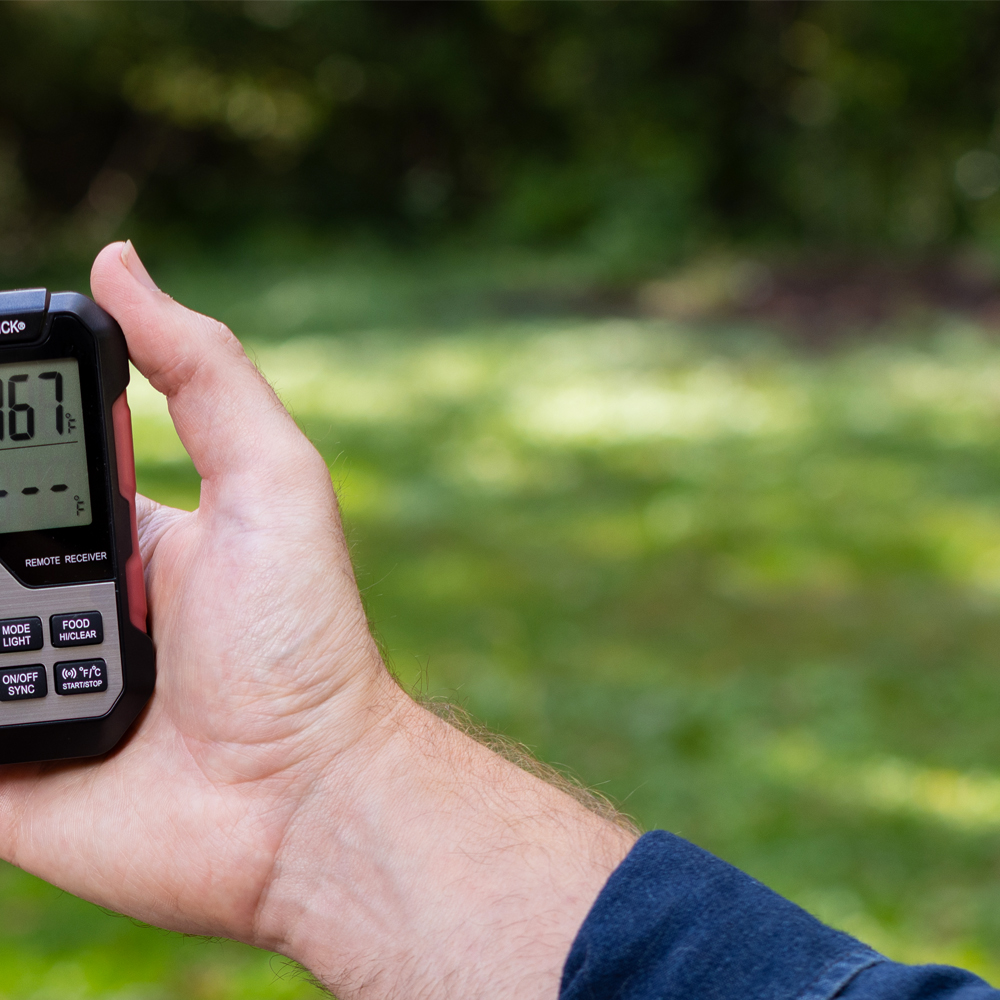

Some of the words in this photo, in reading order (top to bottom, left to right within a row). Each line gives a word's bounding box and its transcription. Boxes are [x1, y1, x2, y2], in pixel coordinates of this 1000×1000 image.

[25, 556, 61, 567] REMOTE
[64, 551, 108, 565] RECEIVER
[2, 623, 31, 635] MODE
[62, 618, 91, 630] FOOD
[3, 635, 31, 647] LIGHT
[59, 630, 97, 641] HI/CLEAR
[2, 671, 39, 685] ON/OFF
[8, 684, 36, 696] SYNC
[62, 680, 103, 690] START/STOP
